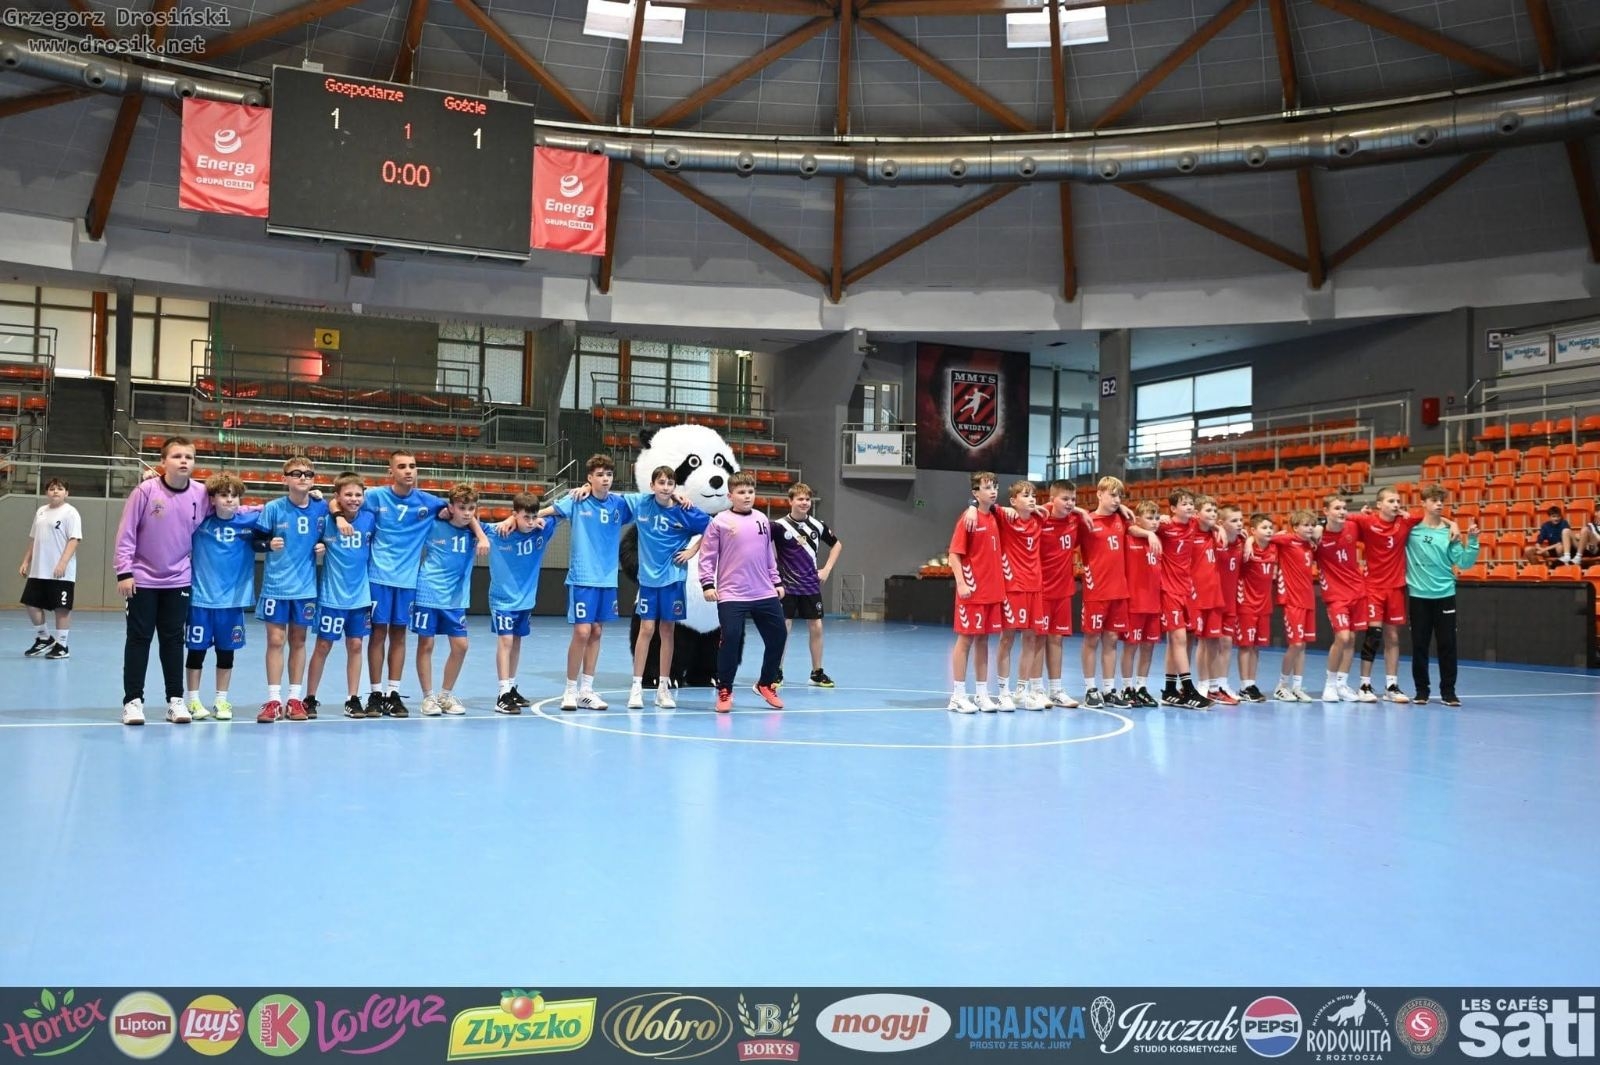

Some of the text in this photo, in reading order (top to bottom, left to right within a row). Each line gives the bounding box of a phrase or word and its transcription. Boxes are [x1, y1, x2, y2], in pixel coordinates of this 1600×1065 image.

[325, 78, 404, 102] Gospodarze
[444, 97, 487, 115] Goście
[331, 107, 340, 129] 1
[404, 122, 411, 139] 1
[473, 128, 482, 149] 1
[196, 154, 255, 176] Energa
[382, 160, 430, 187] 0:00
[196, 176, 254, 190] GRUPA ORLEN
[544, 198, 595, 218] Energa
[545, 218, 593, 231] GRUPA ORLEN
[322, 333, 332, 345] C
[954, 372, 996, 384] MMTS
[1102, 380, 1116, 395] B2
[957, 422, 991, 432] KWIDZYN
[192, 502, 197, 520] 1
[396, 504, 409, 522] 7
[600, 508, 609, 524] 6
[55, 521, 61, 530] 2
[297, 516, 309, 534] 8
[653, 514, 670, 532] 15
[756, 520, 768, 536] 16
[340, 530, 363, 549] 98
[451, 536, 467, 554] 11
[515, 538, 533, 557] 10
[1027, 536, 1034, 551] 9
[1059, 534, 1072, 550] 19
[1107, 535, 1120, 550] 15
[1176, 539, 1184, 554] 7
[1386, 535, 1394, 549] 3
[1423, 535, 1434, 545] 32
[1145, 551, 1157, 566] 16
[1304, 551, 1312, 567] 5
[1336, 548, 1348, 563] 14
[1229, 557, 1236, 571] 6
[61, 591, 68, 603] 2
[264, 598, 276, 617] 8
[575, 602, 586, 619] 6
[1368, 604, 1376, 618] 3
[319, 614, 345, 634] 98
[414, 611, 429, 630] 11
[975, 613, 982, 629] 2
[1019, 608, 1027, 624] 9
[1091, 614, 1104, 629] 15
[1172, 610, 1180, 625] 7
[1132, 628, 1142, 641] 16
[1297, 624, 1304, 638] 5
